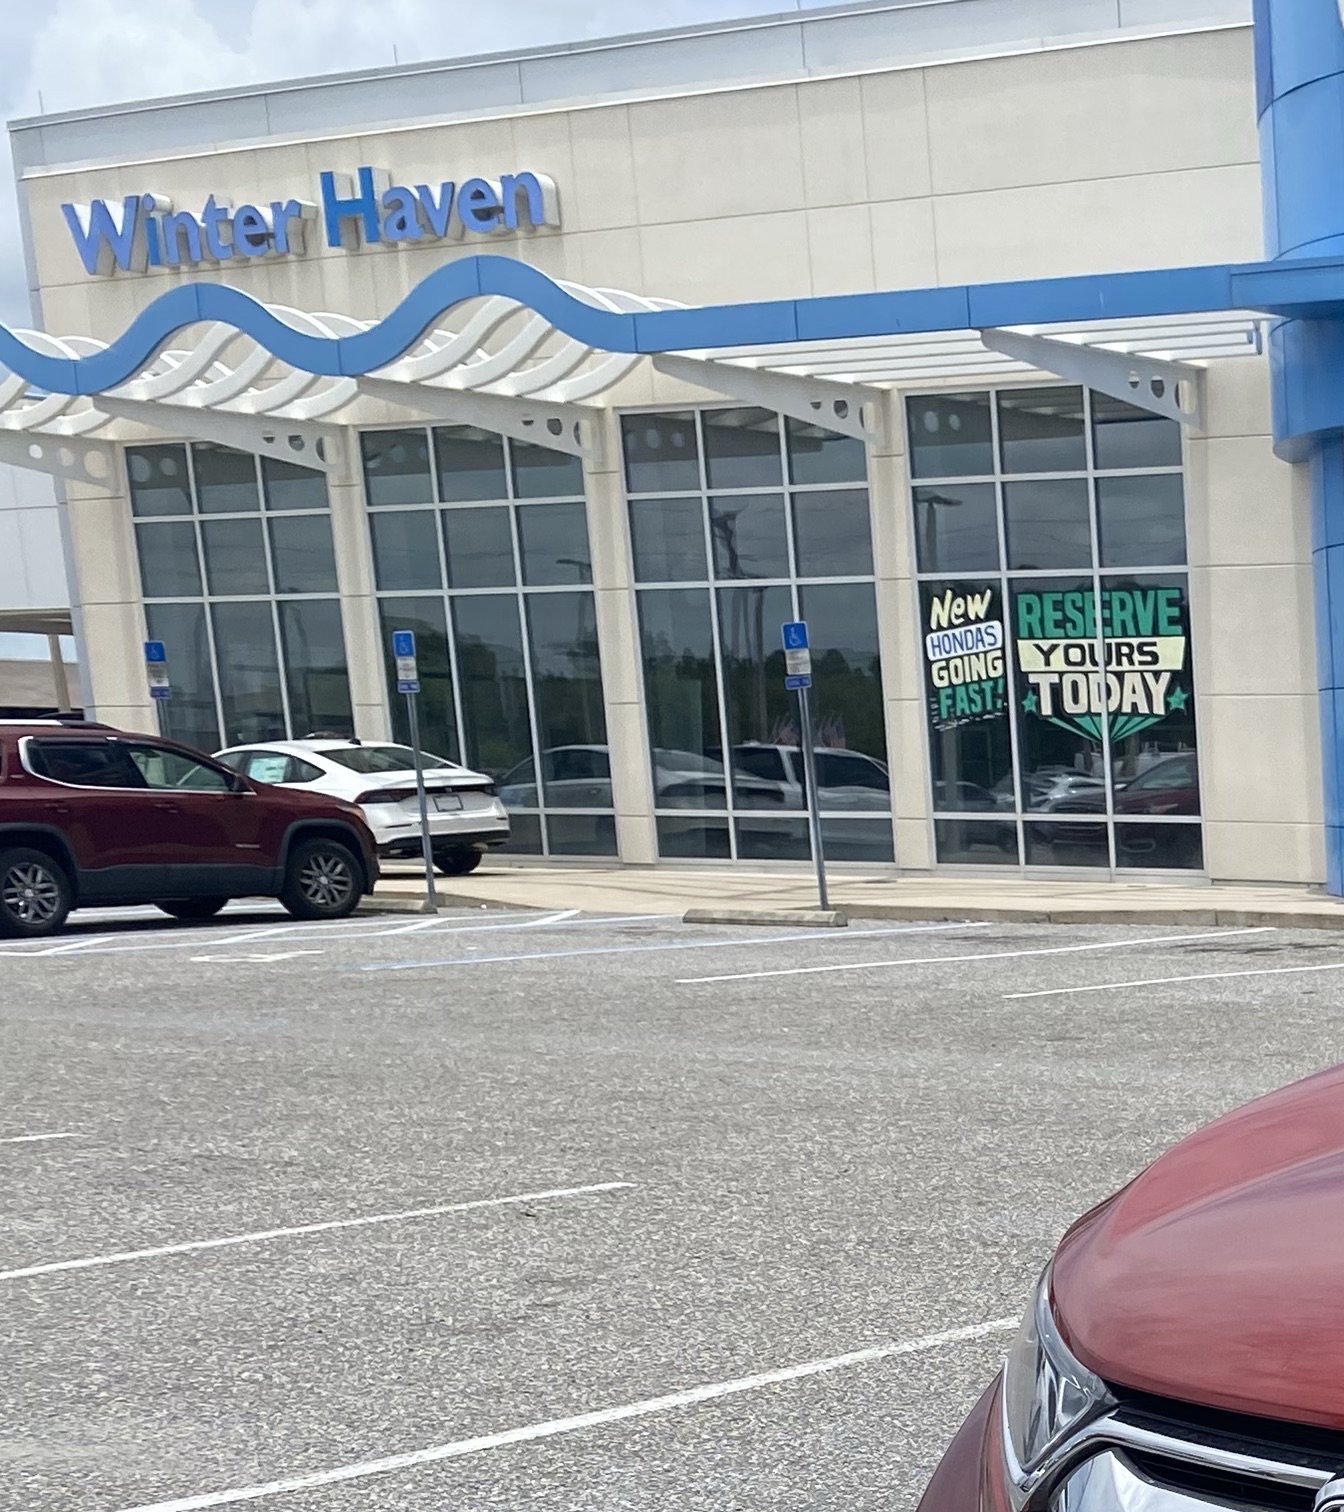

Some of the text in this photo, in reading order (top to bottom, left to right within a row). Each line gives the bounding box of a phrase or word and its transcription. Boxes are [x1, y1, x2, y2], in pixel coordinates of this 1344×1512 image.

[62, 166, 549, 277] Winter Haven
[930, 588, 991, 630] New
[1017, 589, 1183, 639] RESERVE
[930, 625, 998, 657] HONDAS
[1033, 641, 1160, 667] YOURS
[931, 649, 1004, 688] GOING
[939, 677, 1005, 720] FAST!
[1028, 672, 1172, 716] TODAY
